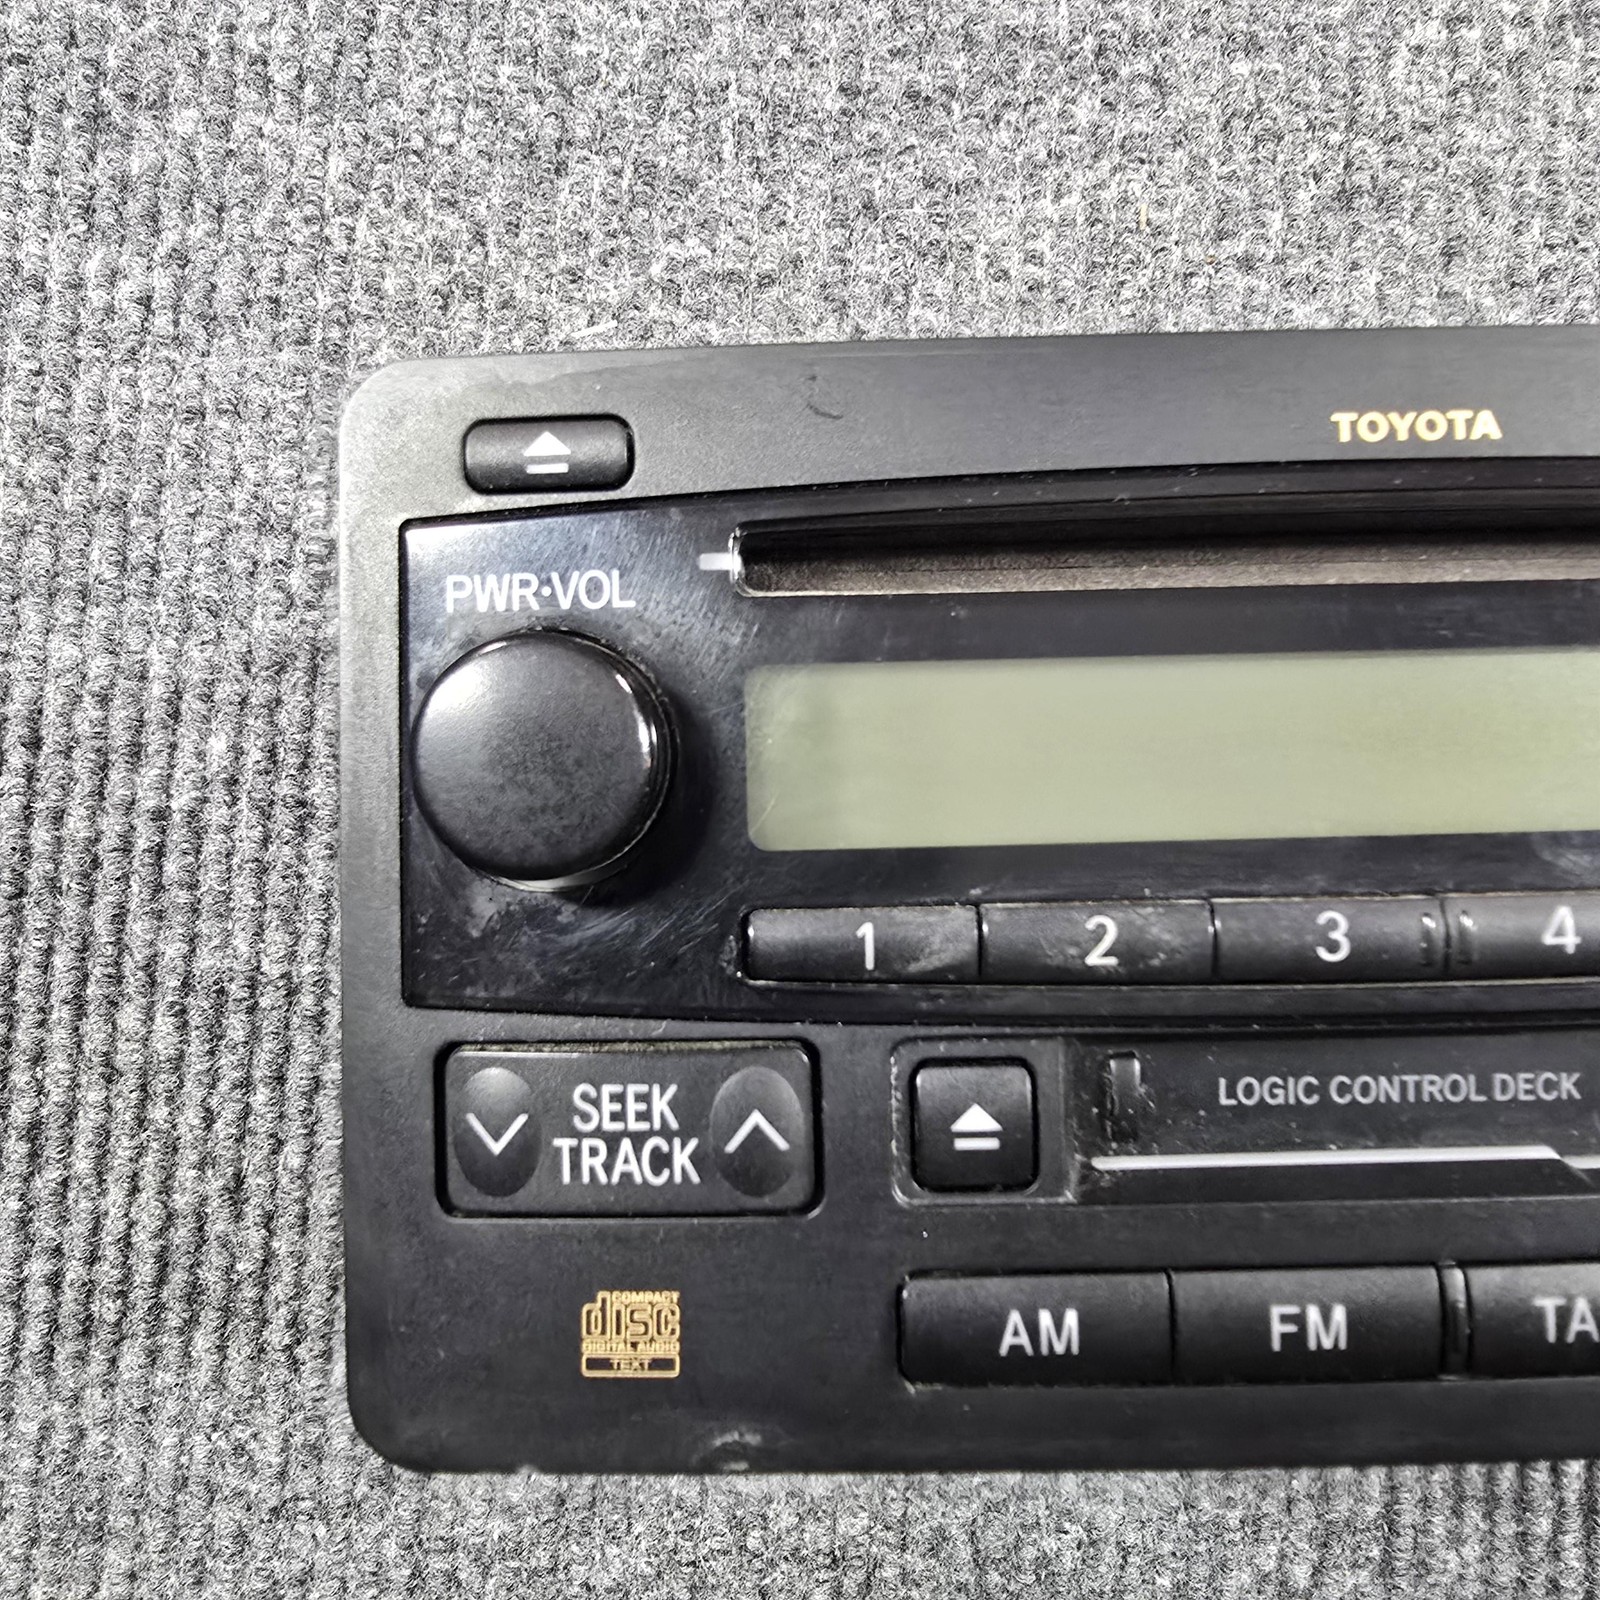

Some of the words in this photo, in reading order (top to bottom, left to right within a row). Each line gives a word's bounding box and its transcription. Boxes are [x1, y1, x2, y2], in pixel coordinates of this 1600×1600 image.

[1330, 410, 1503, 443] TOYOTA
[855, 921, 877, 971] 1
[1083, 915, 1120, 968] 2
[1315, 911, 1353, 963] 3
[1542, 906, 1583, 955] 4
[572, 1083, 680, 1132] SEEK
[1217, 1076, 1320, 1107] LOGIC
[1328, 1073, 1487, 1105] CONTROL
[1492, 1071, 1582, 1101] DECK
[552, 1136, 701, 1187] TRACK
[998, 1308, 1081, 1357] AM
[1269, 1304, 1350, 1352] FM
[609, 1358, 653, 1371] TEXT
